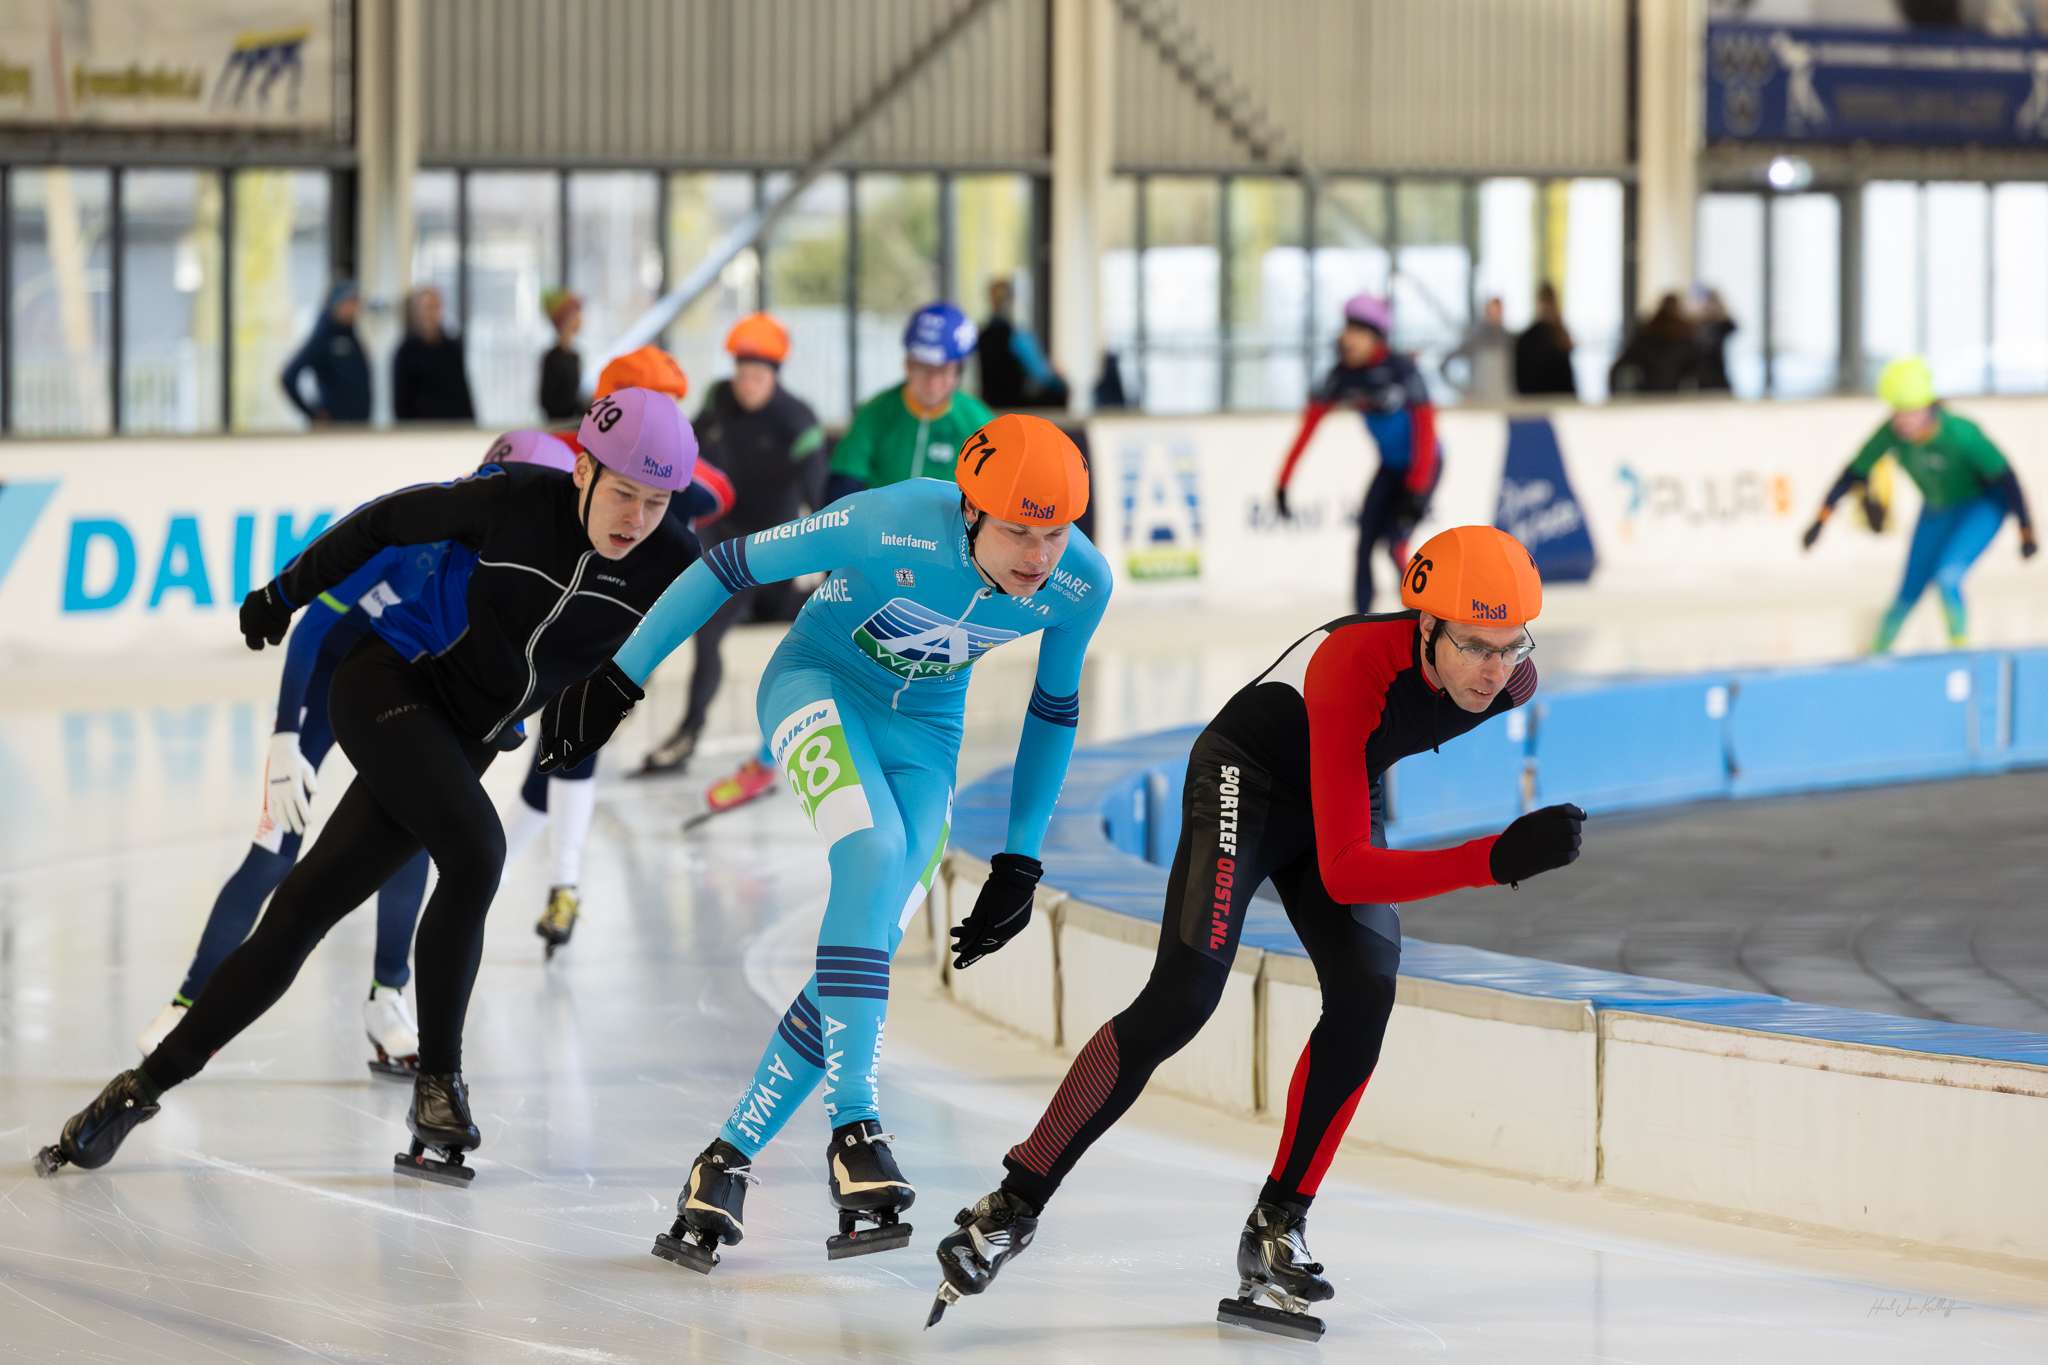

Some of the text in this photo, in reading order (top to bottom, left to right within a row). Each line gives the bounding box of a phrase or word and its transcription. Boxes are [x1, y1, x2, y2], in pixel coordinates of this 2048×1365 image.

[881, 532, 937, 551] interfarms
[1219, 765, 1240, 856] SPORTIEF
[1209, 857, 1236, 950] OOST.NL
